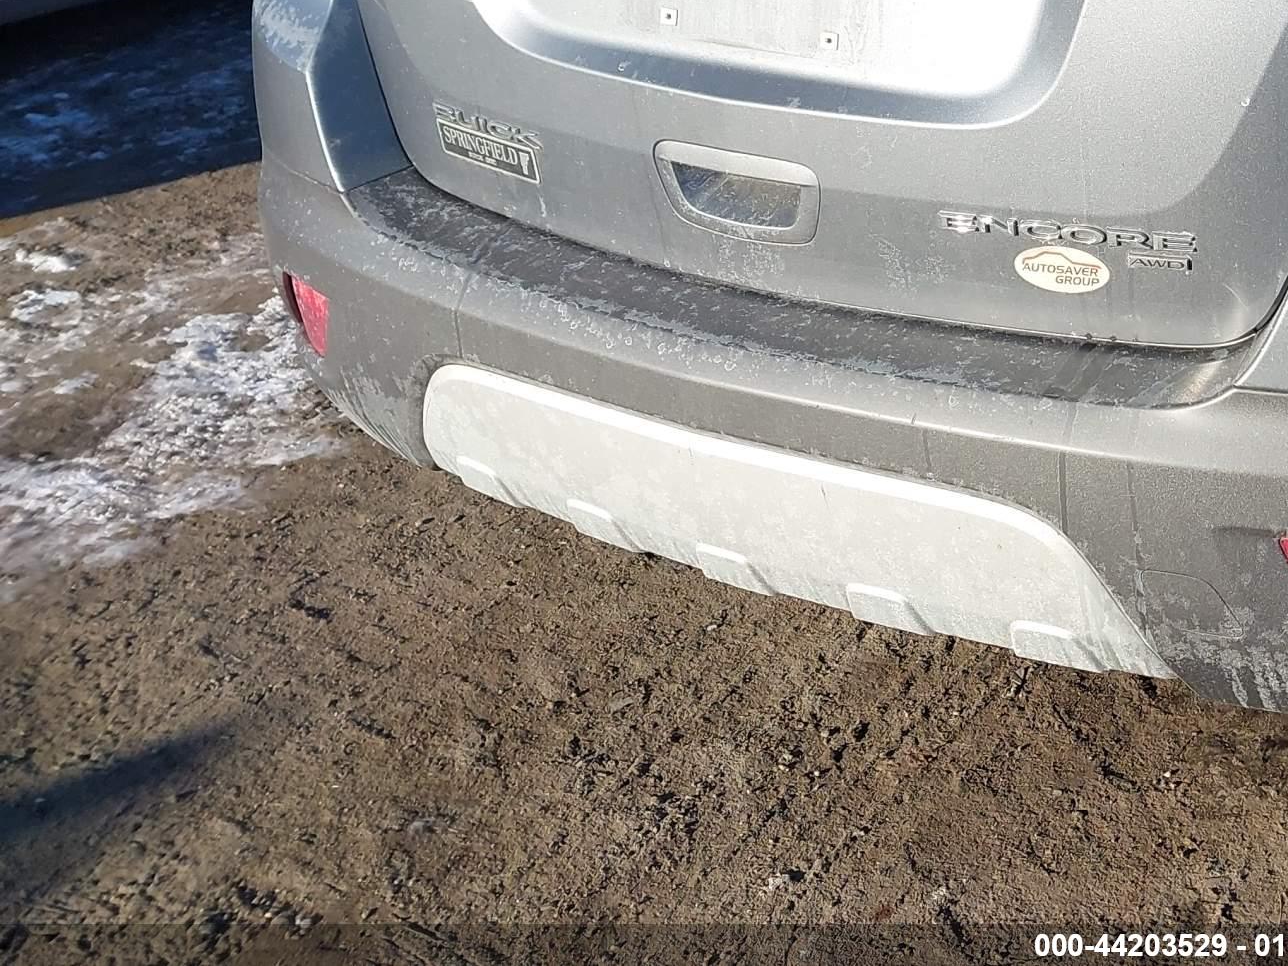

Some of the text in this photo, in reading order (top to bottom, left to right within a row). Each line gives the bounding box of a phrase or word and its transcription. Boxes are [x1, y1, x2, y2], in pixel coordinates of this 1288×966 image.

[432, 100, 543, 150] BUICK
[442, 126, 518, 166] SPRINGFIELD
[938, 210, 1199, 253] ENCORE
[1022, 262, 1100, 277] AUTOSAVER
[1128, 256, 1187, 271] AWD
[1055, 275, 1100, 287] GROUP
